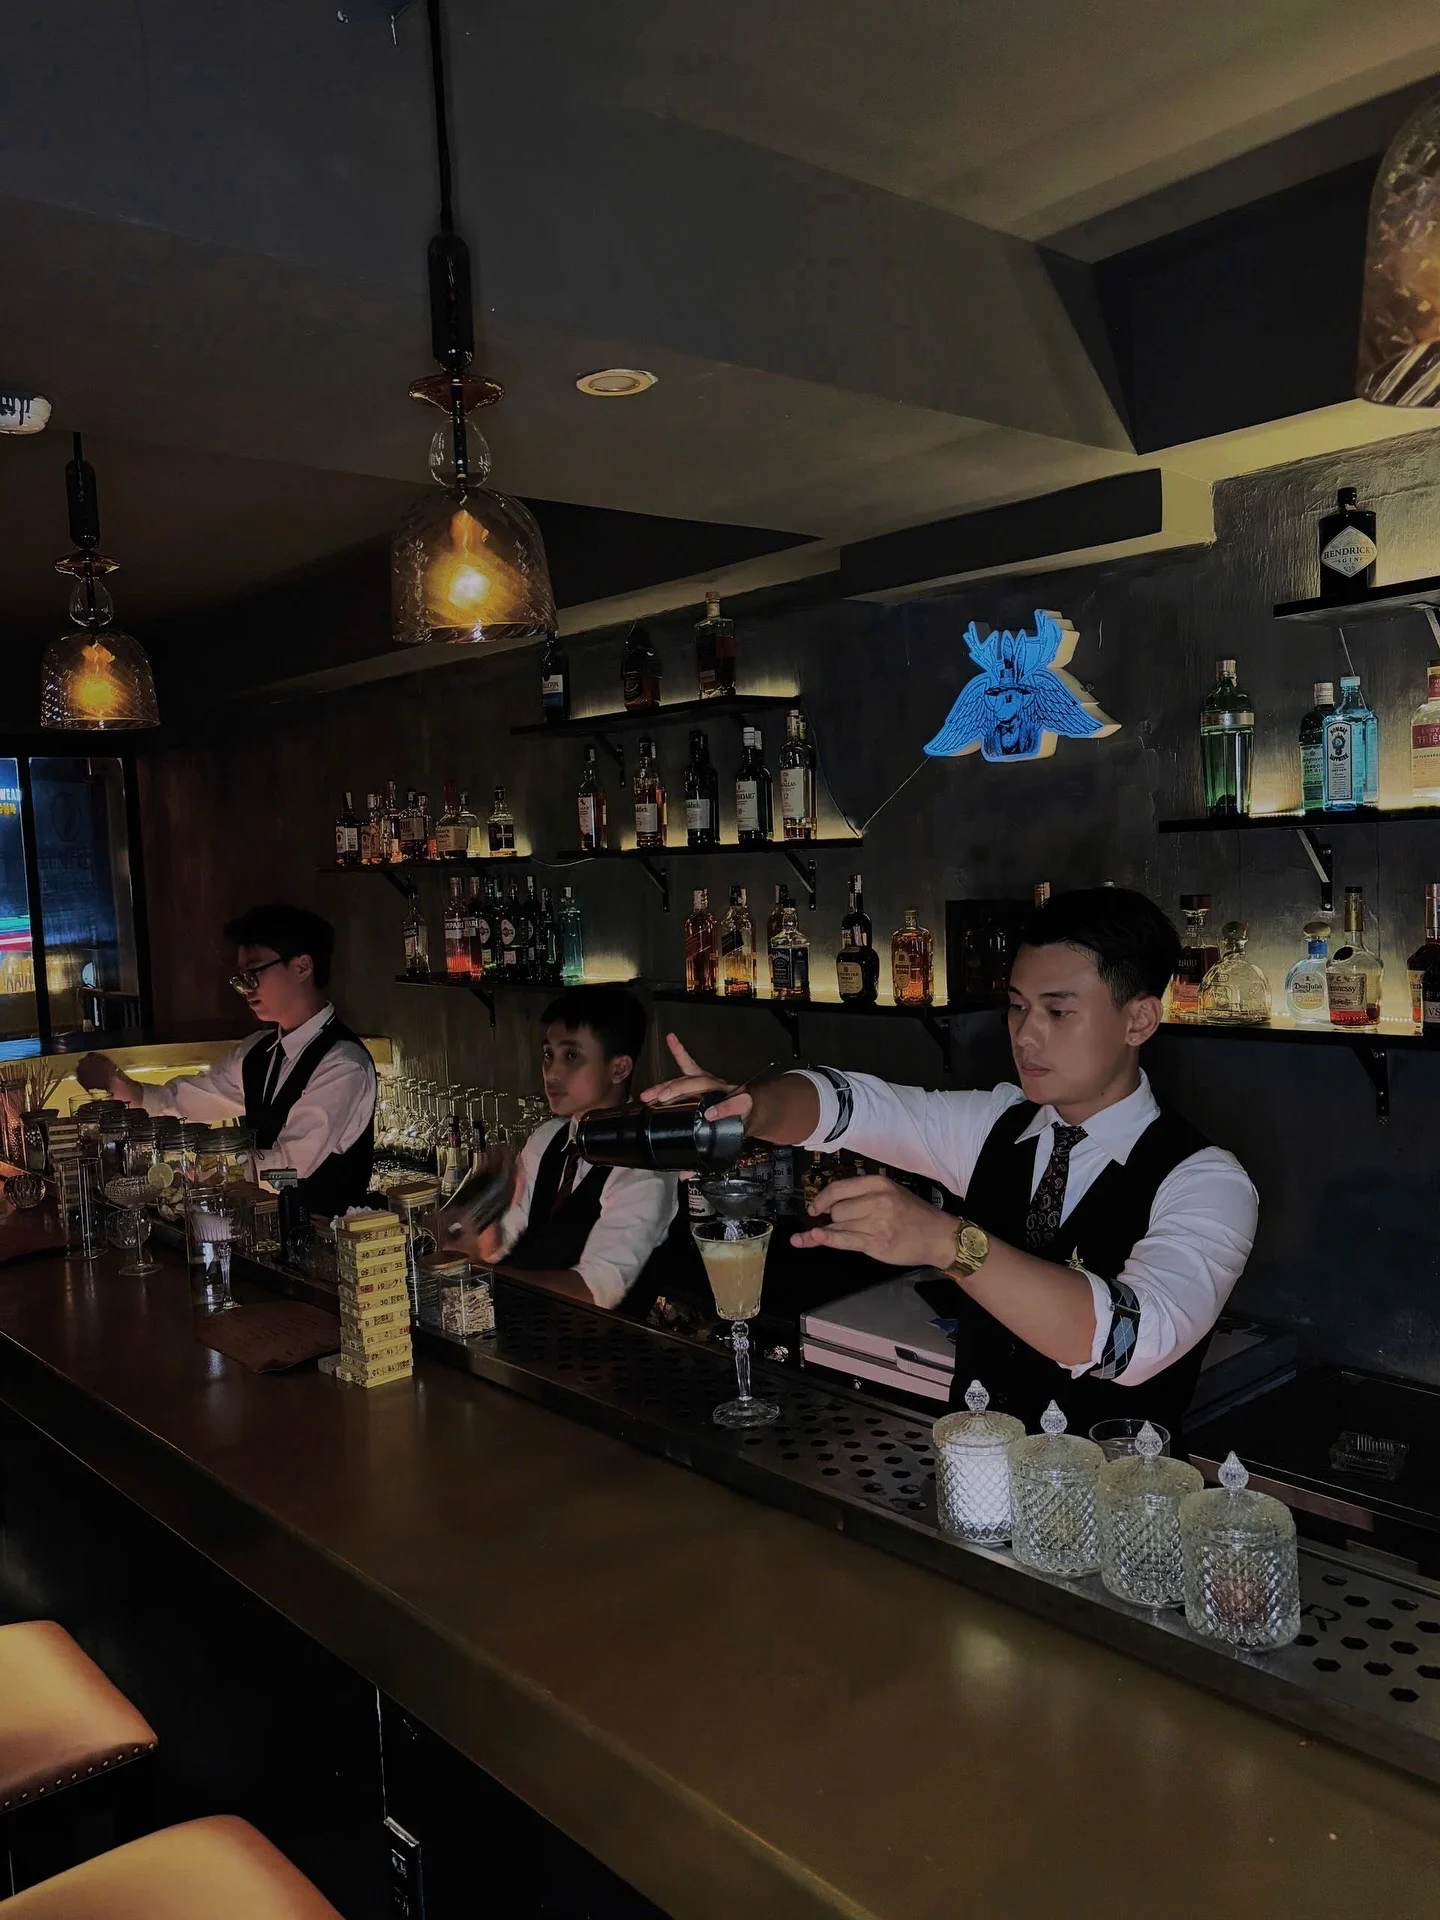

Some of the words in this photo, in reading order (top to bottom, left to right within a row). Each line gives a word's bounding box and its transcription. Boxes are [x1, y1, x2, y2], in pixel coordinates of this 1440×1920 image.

[1177, 958, 1197, 968] 1800
[1294, 982, 1308, 990] Don
[1307, 983, 1323, 992] Julio
